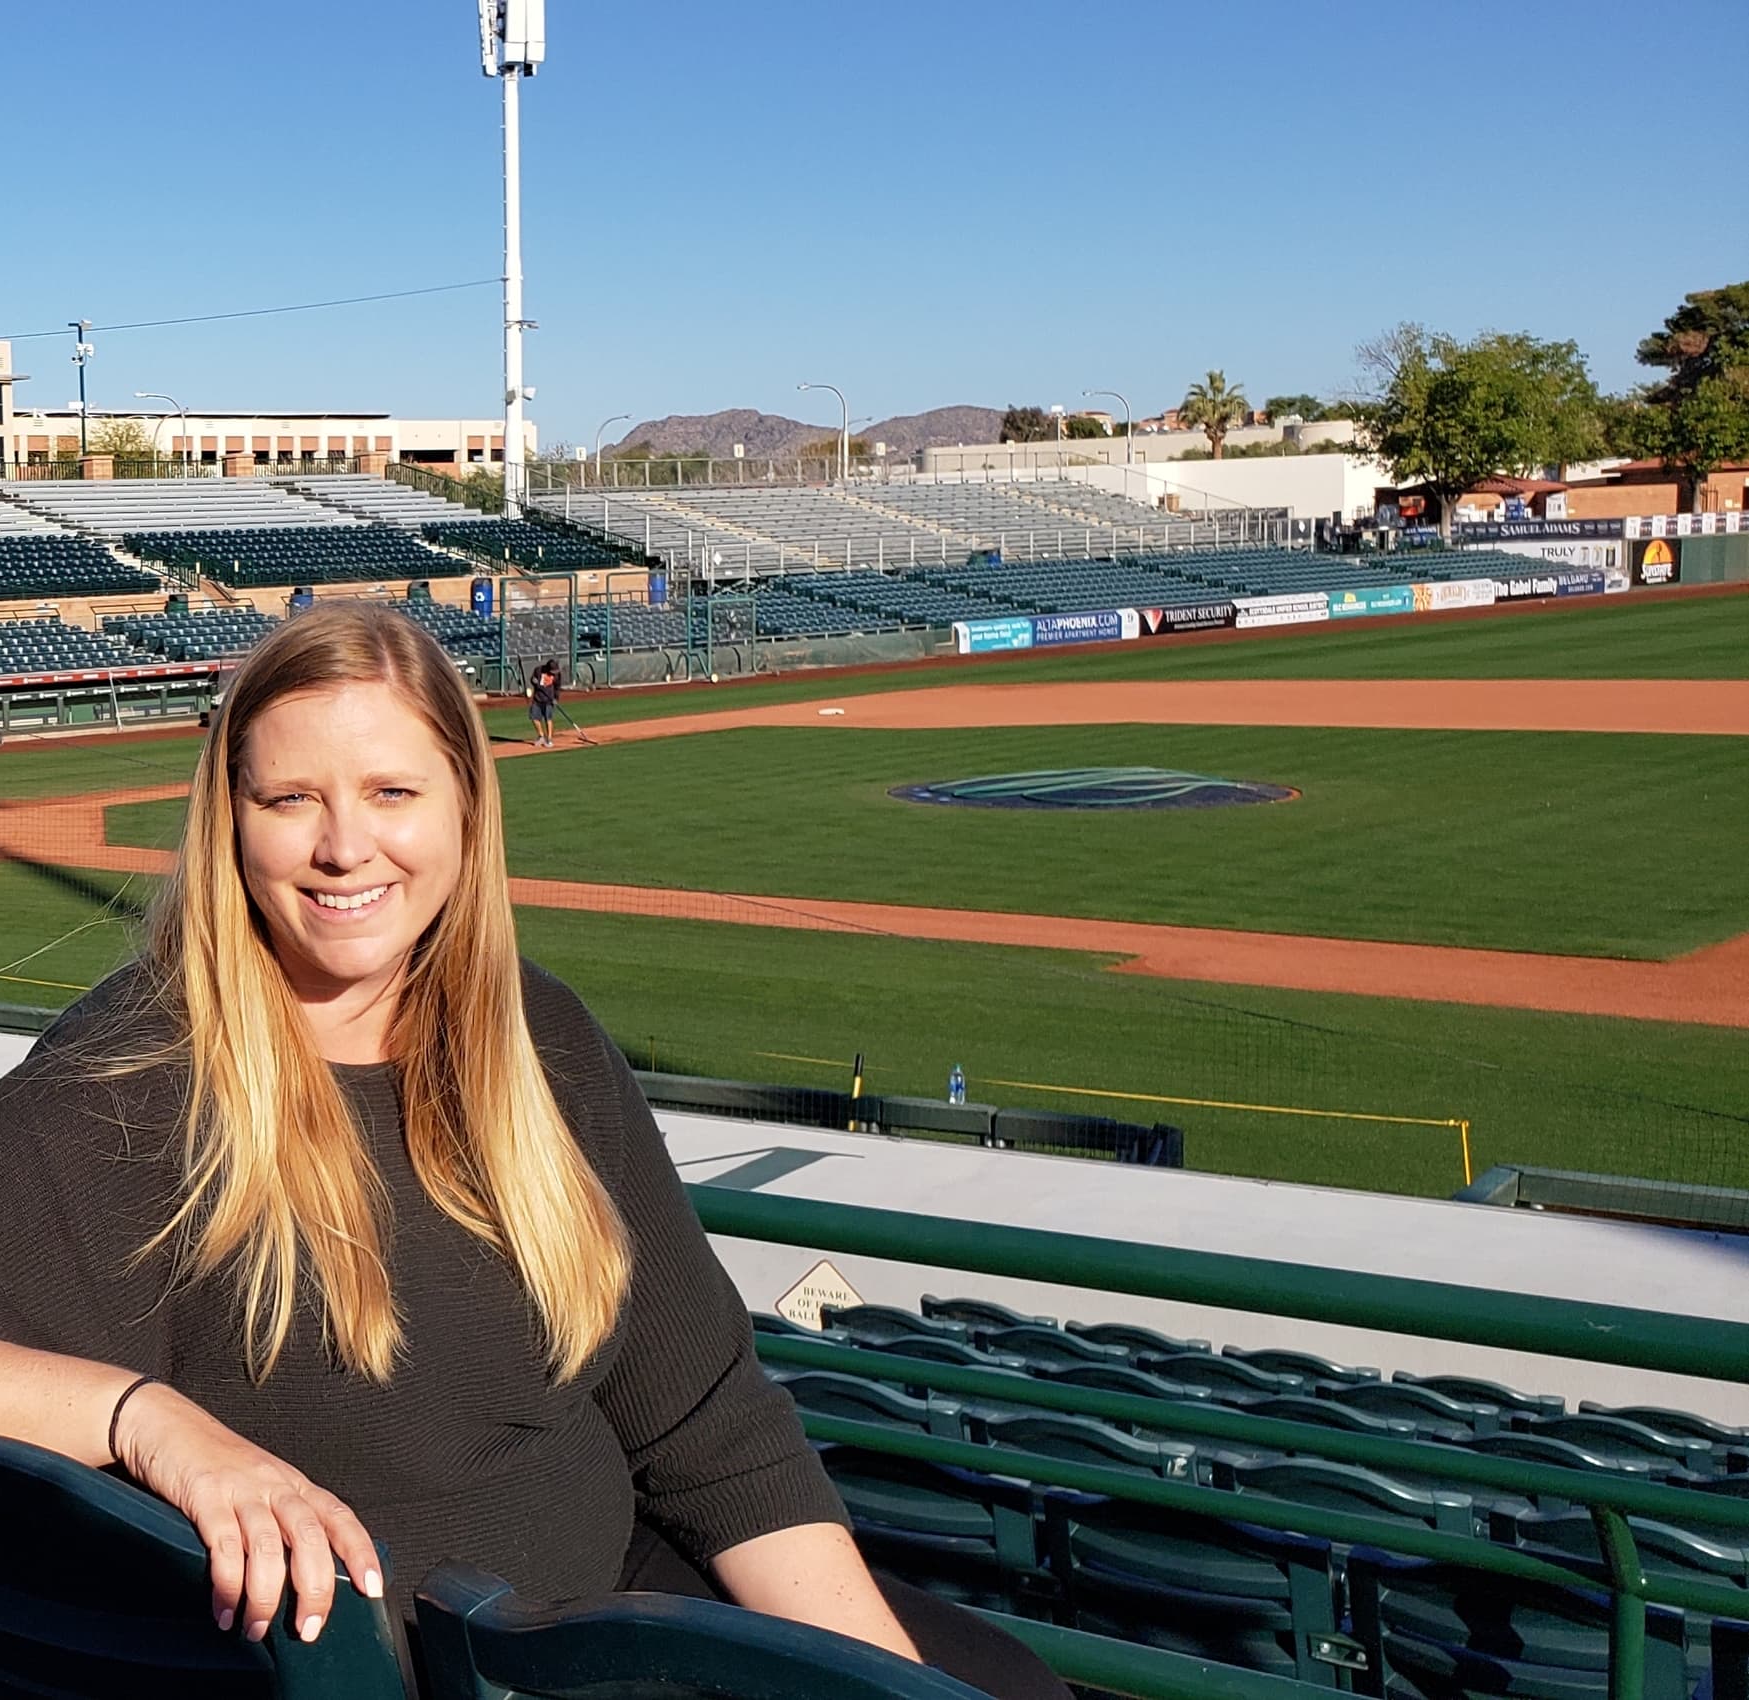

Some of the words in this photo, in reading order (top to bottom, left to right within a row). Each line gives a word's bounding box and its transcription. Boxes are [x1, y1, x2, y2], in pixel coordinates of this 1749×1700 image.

[1501, 524, 1541, 537] SAMUEL
[1543, 522, 1581, 535] ADAMS
[1540, 547, 1575, 558] TRULY
[1165, 608, 1197, 625] TRIDENT
[1197, 605, 1233, 620] SECURITY
[1036, 630, 1063, 641] PREMIER
[1064, 629, 1098, 640] APARTMENT
[1099, 627, 1118, 637] HOMES
[803, 1287, 847, 1301] BEWARE
[797, 1299, 810, 1308] OF
[788, 1309, 816, 1321] BALL
